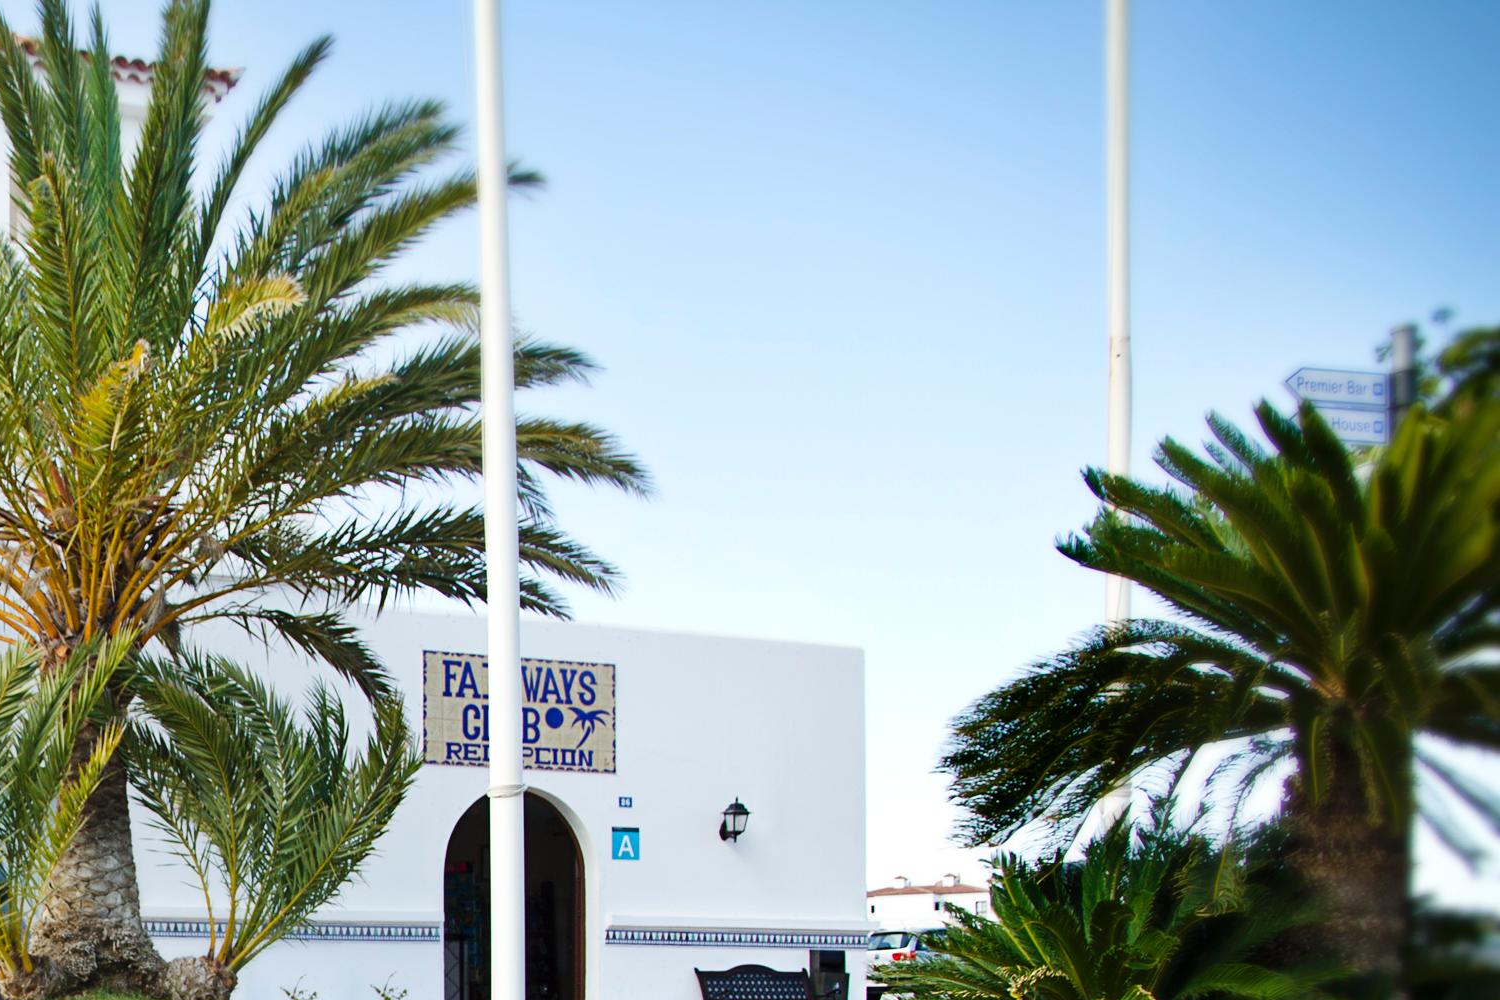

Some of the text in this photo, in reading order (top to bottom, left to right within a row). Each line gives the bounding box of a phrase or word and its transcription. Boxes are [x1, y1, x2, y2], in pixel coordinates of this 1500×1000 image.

[1296, 376, 1367, 395] Premier Bar
[1331, 417, 1372, 432] House
[442, 659, 598, 706] FAWAYS
[618, 834, 635, 858] A
